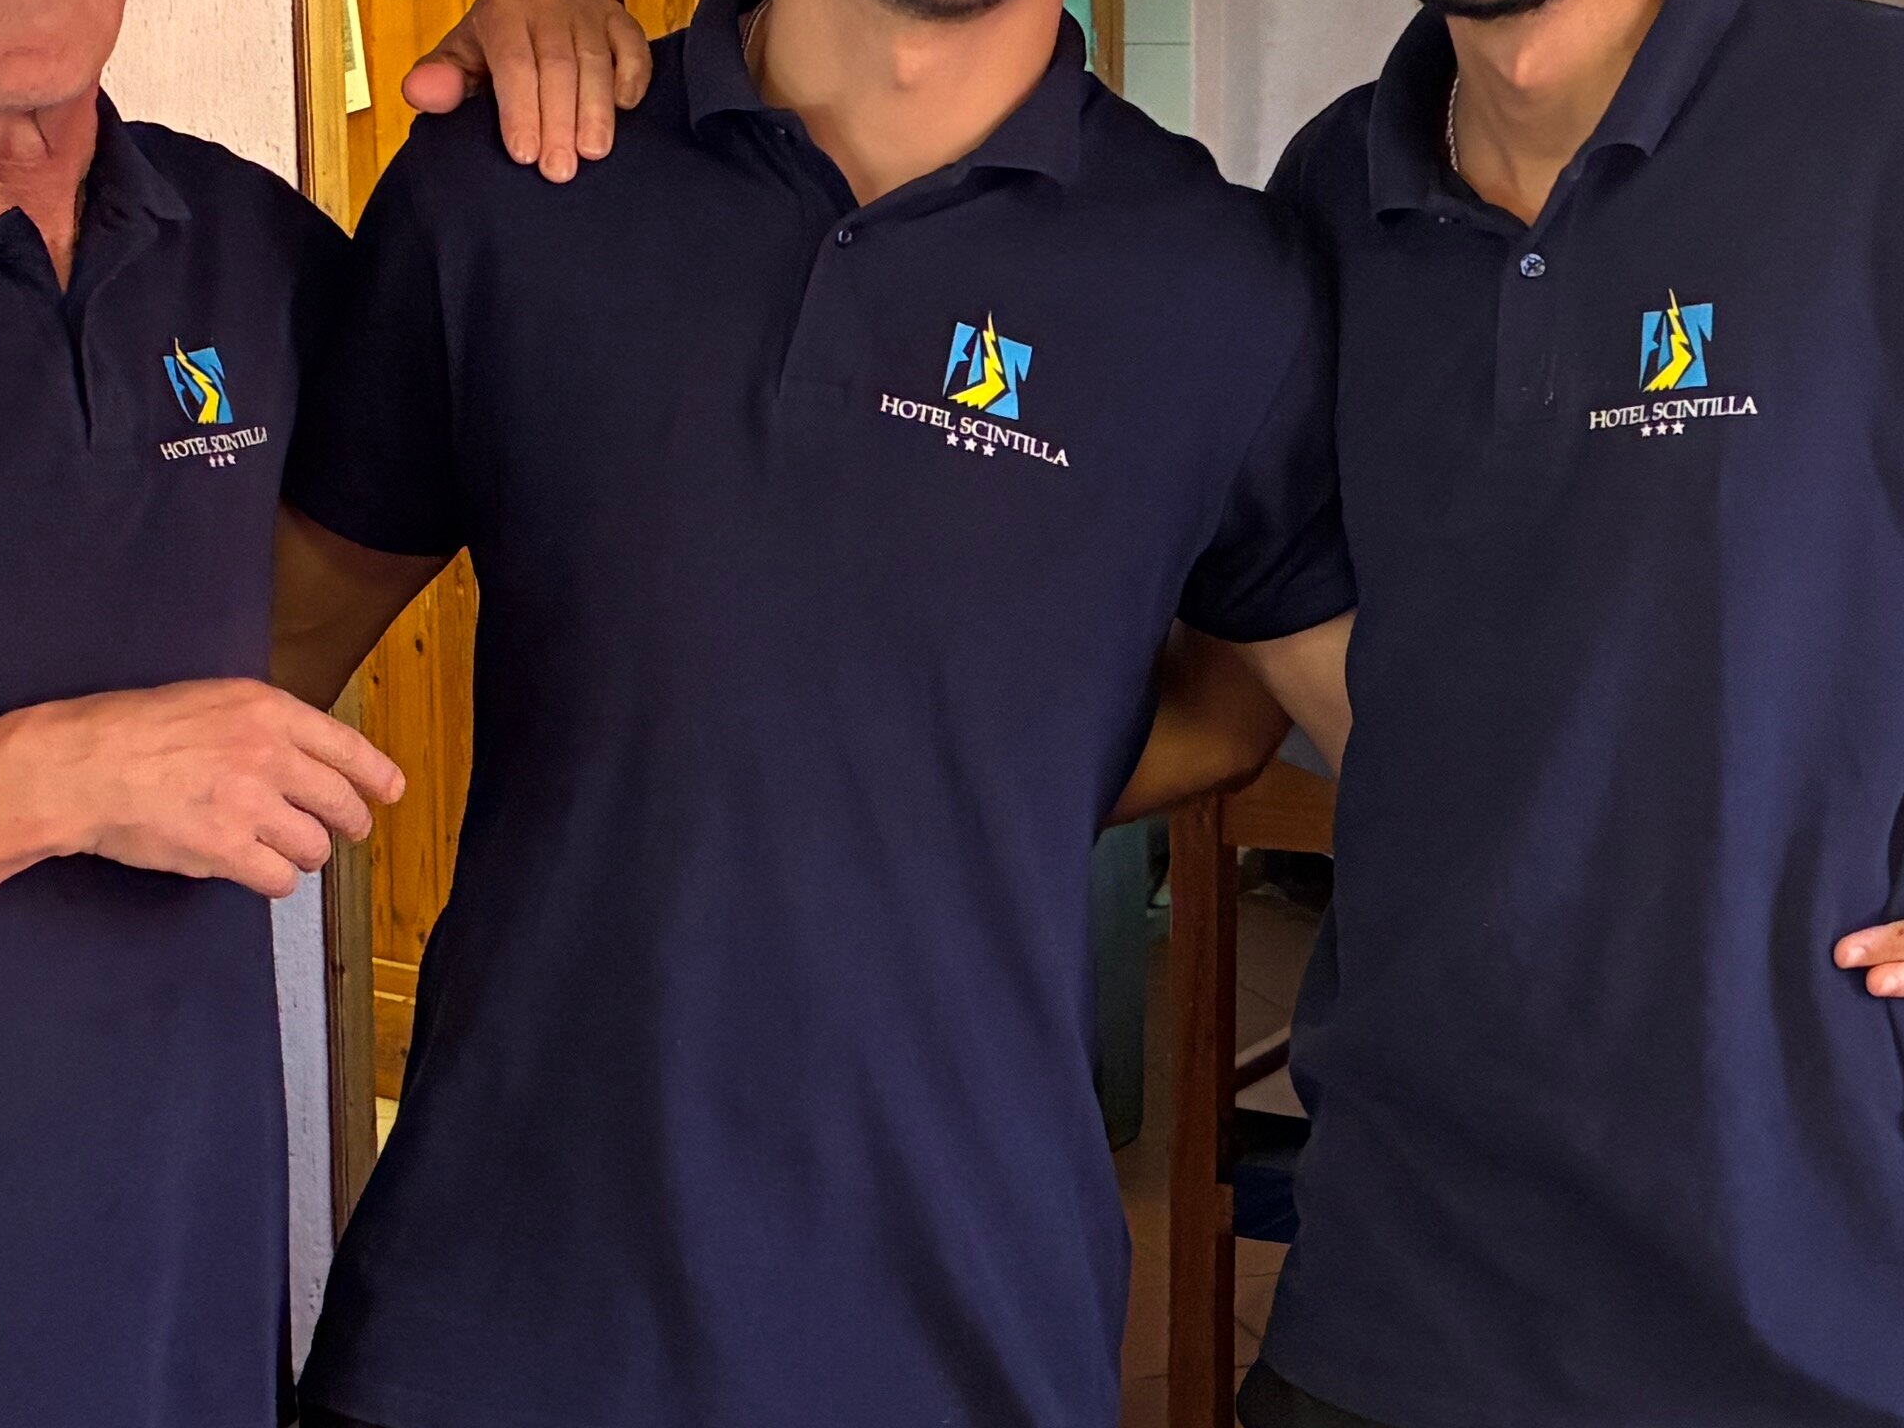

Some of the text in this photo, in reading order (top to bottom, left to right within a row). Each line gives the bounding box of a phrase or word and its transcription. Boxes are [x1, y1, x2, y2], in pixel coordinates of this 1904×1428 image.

[880, 393, 1070, 467] HOTEL SCINTILLA
[1589, 395, 1758, 430] HOTEL SCINTILLA
[160, 426, 268, 460] HOTEL SCINTILLA
